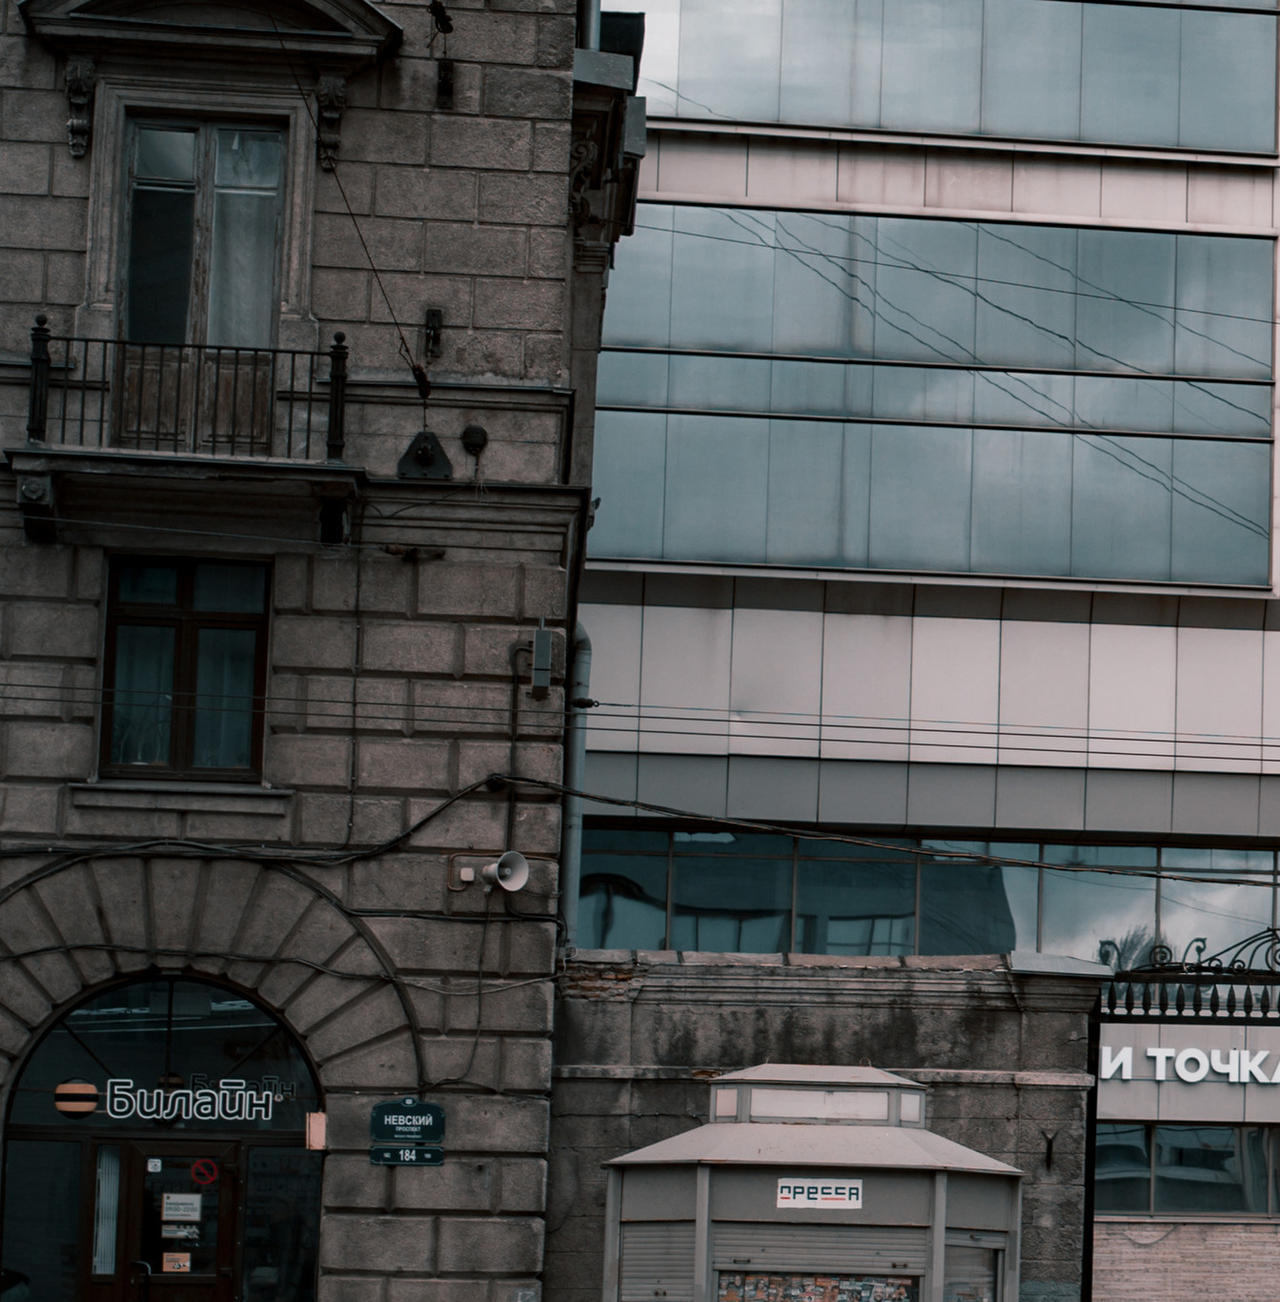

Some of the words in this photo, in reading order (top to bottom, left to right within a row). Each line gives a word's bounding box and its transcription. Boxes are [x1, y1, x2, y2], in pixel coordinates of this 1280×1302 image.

[1101, 1046, 1133, 1079] И
[106, 1078, 273, 1121] Билайн
[384, 1113, 433, 1126] НЕВСКИЙ
[398, 1149, 417, 1161] 184
